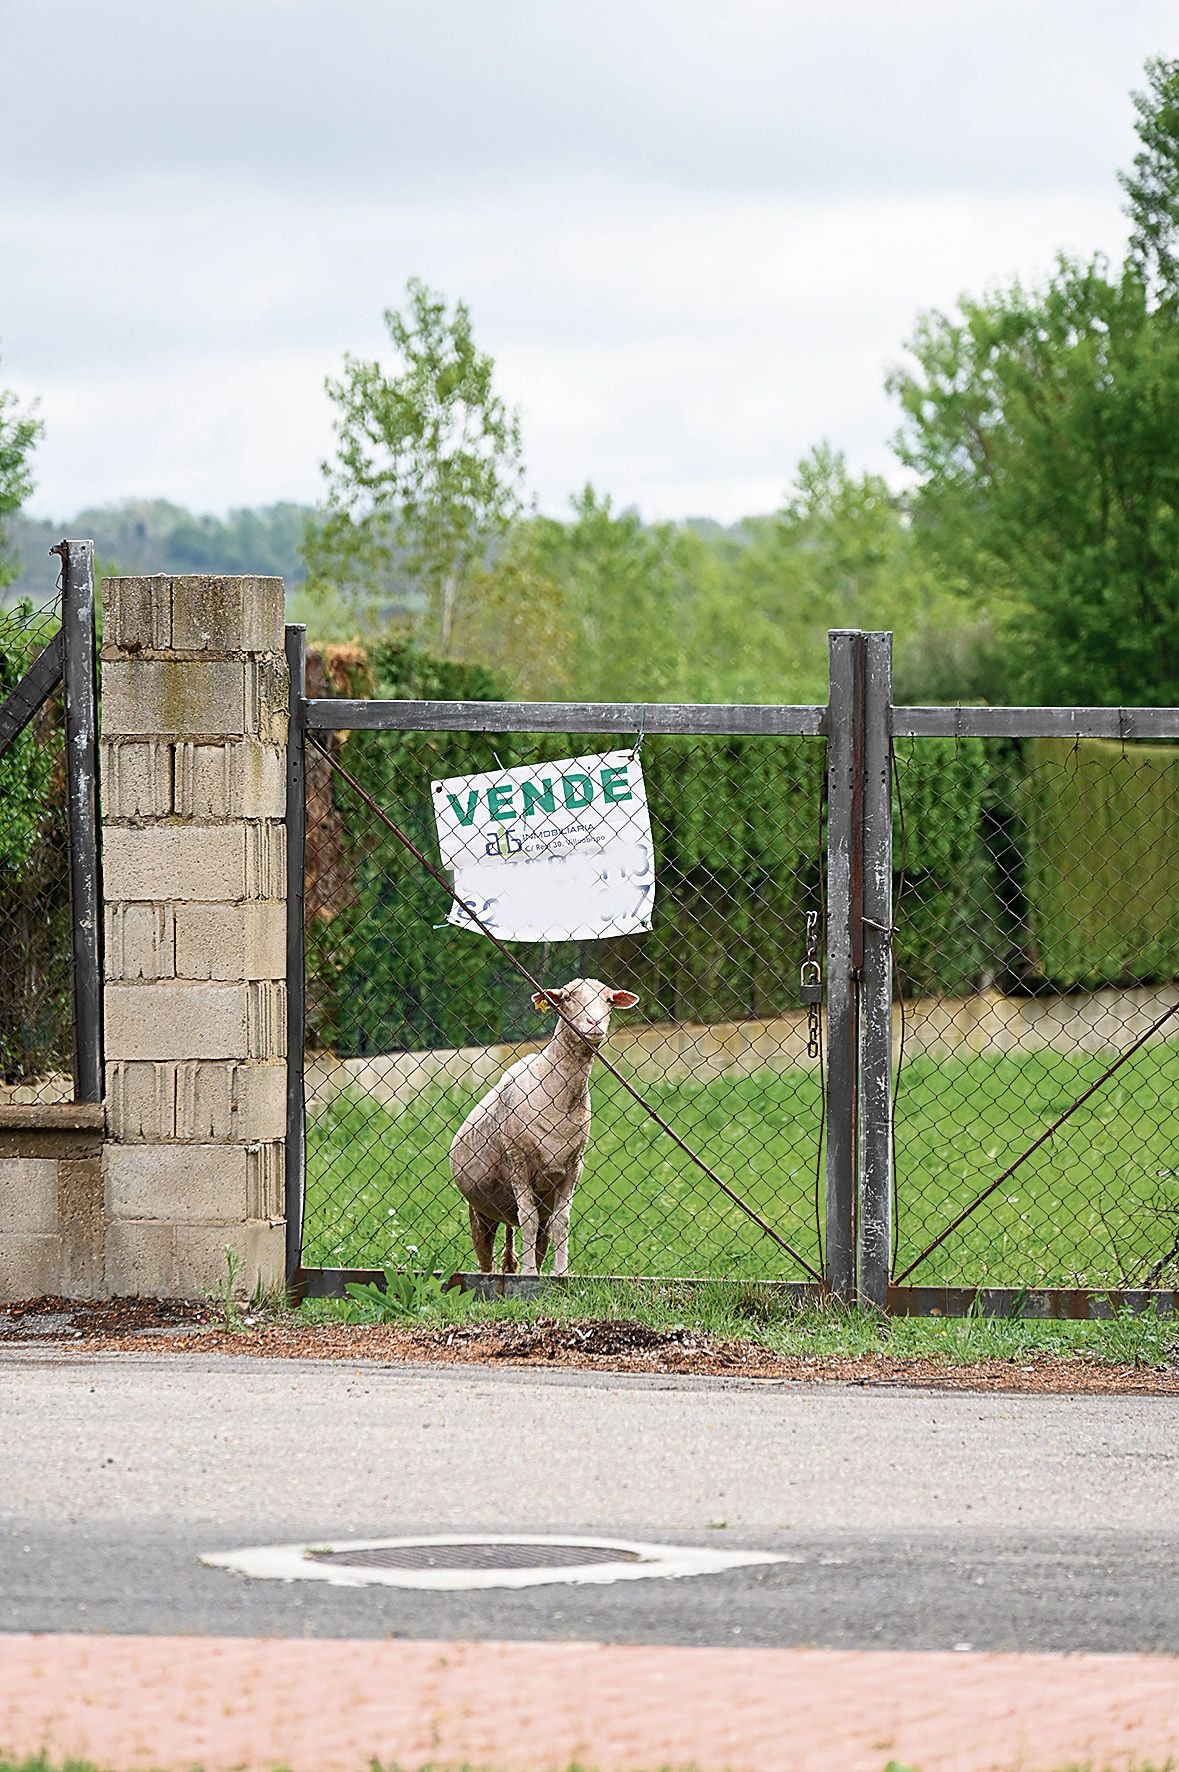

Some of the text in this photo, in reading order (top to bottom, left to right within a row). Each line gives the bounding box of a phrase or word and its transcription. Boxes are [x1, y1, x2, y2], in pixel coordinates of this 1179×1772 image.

[446, 766, 633, 827] VENDE
[522, 823, 594, 840] INMOBLIARIA
[536, 843, 551, 851] Rel
